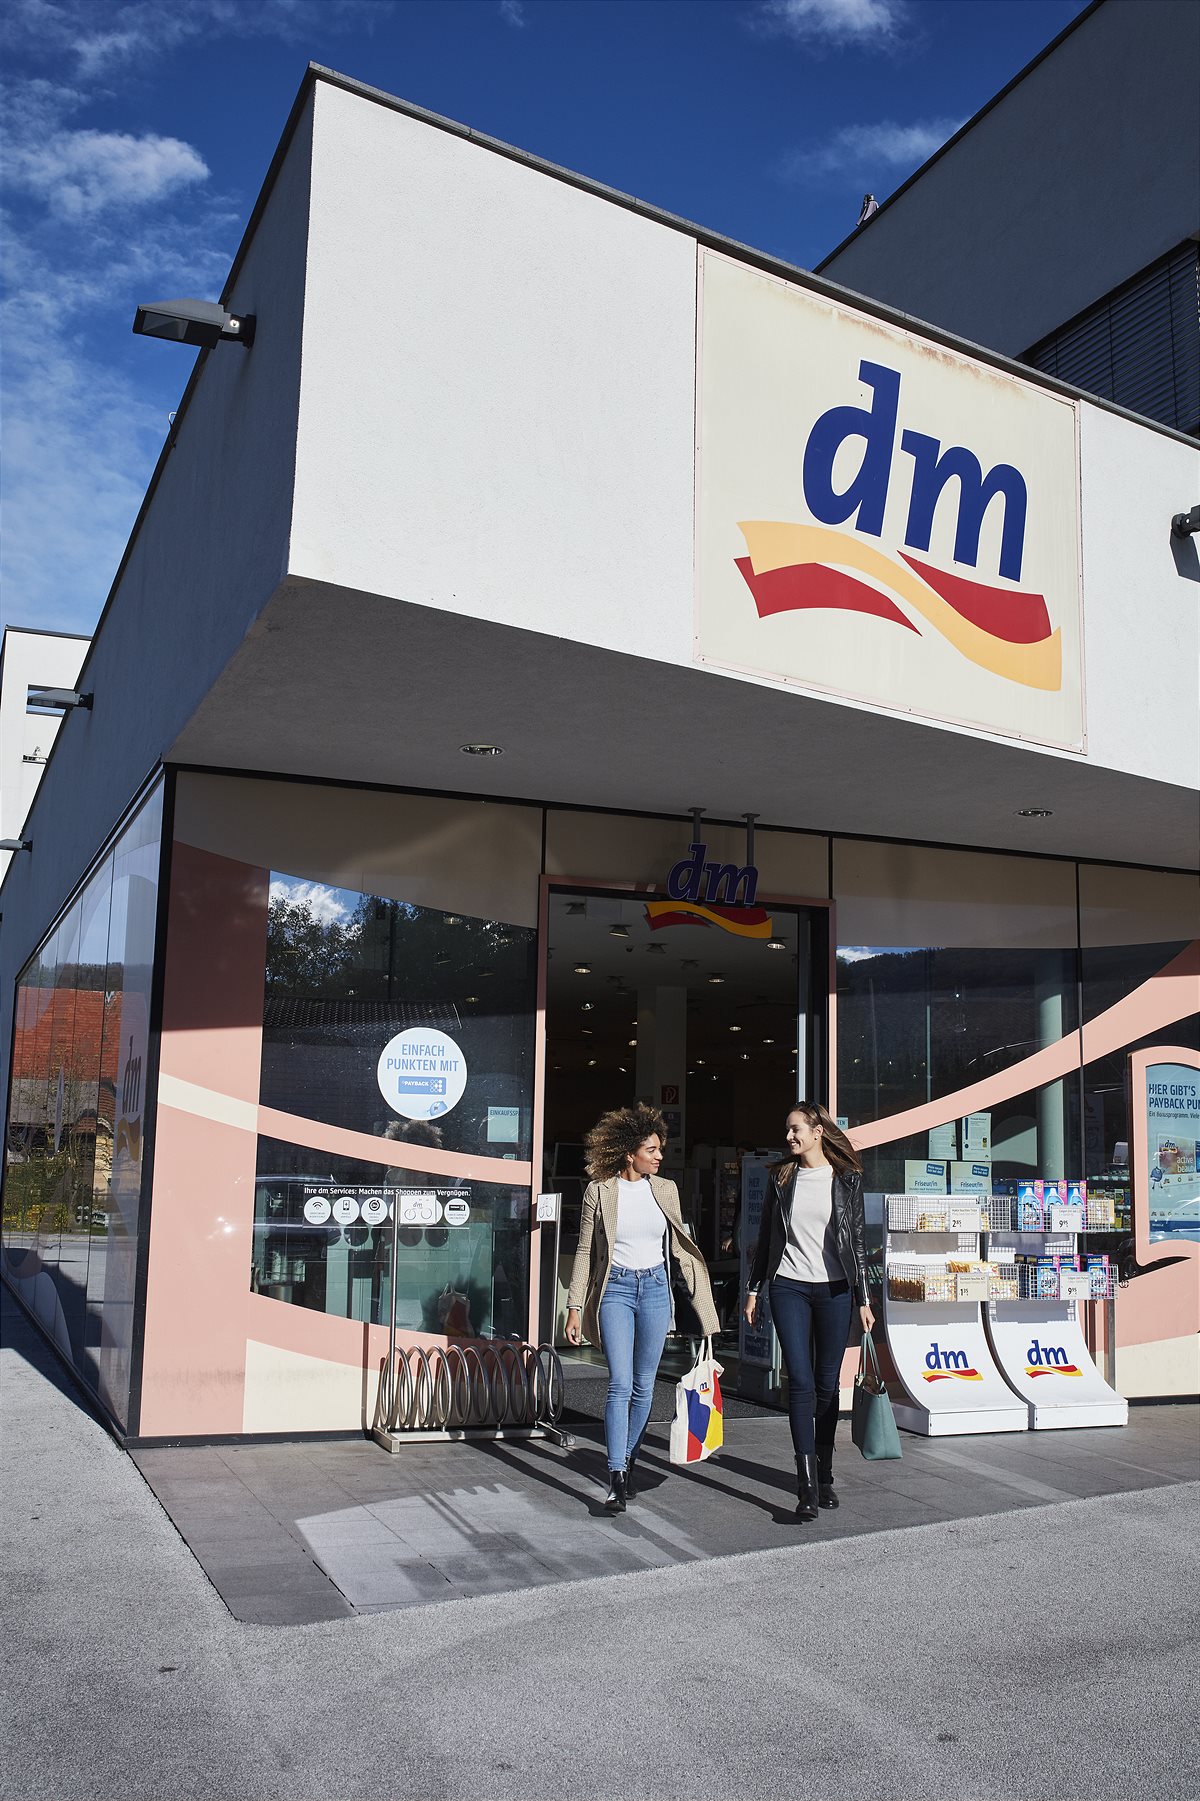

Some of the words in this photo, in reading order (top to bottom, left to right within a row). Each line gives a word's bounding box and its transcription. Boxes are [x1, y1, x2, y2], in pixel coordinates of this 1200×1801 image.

[802, 360, 1028, 582] dm
[667, 843, 759, 905] dm
[401, 1044, 445, 1056] EINFACH
[386, 1058, 437, 1070] PUNKTEN
[440, 1060, 459, 1071] MIT
[1148, 1083, 1168, 1095] HIER
[1170, 1085, 1196, 1096] GIBT'S
[1149, 1097, 1185, 1109] PAYBACK
[436, 1189, 471, 1197] Vergnügen.
[925, 1343, 969, 1369] dm
[1027, 1339, 1069, 1366] dm
